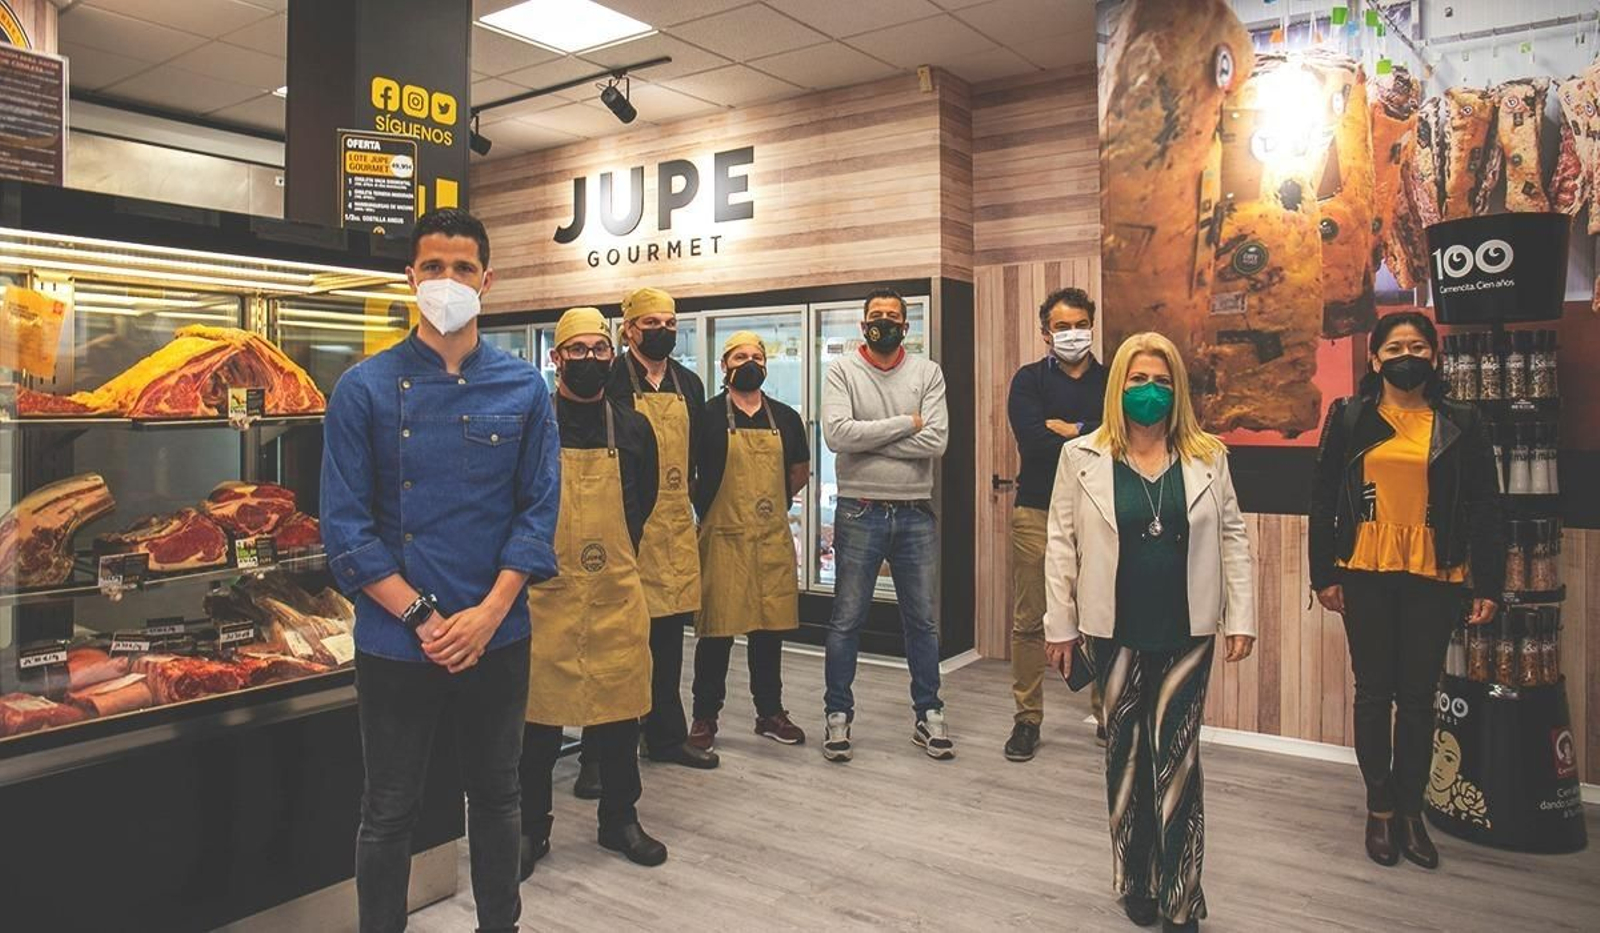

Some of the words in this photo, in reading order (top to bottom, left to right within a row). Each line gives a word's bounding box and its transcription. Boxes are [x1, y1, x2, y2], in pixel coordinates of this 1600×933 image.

[375, 114, 453, 146] SÍGUENOS
[346, 138, 381, 151] OFERTA
[348, 163, 389, 174] GOURMET
[349, 153, 367, 163] LOTE
[371, 155, 389, 164] JUPE
[553, 145, 754, 245] JUPE
[587, 235, 723, 268] GOURMET
[1431, 238, 1514, 281] 100
[1476, 280, 1495, 291] Cien
[1496, 278, 1515, 289] años
